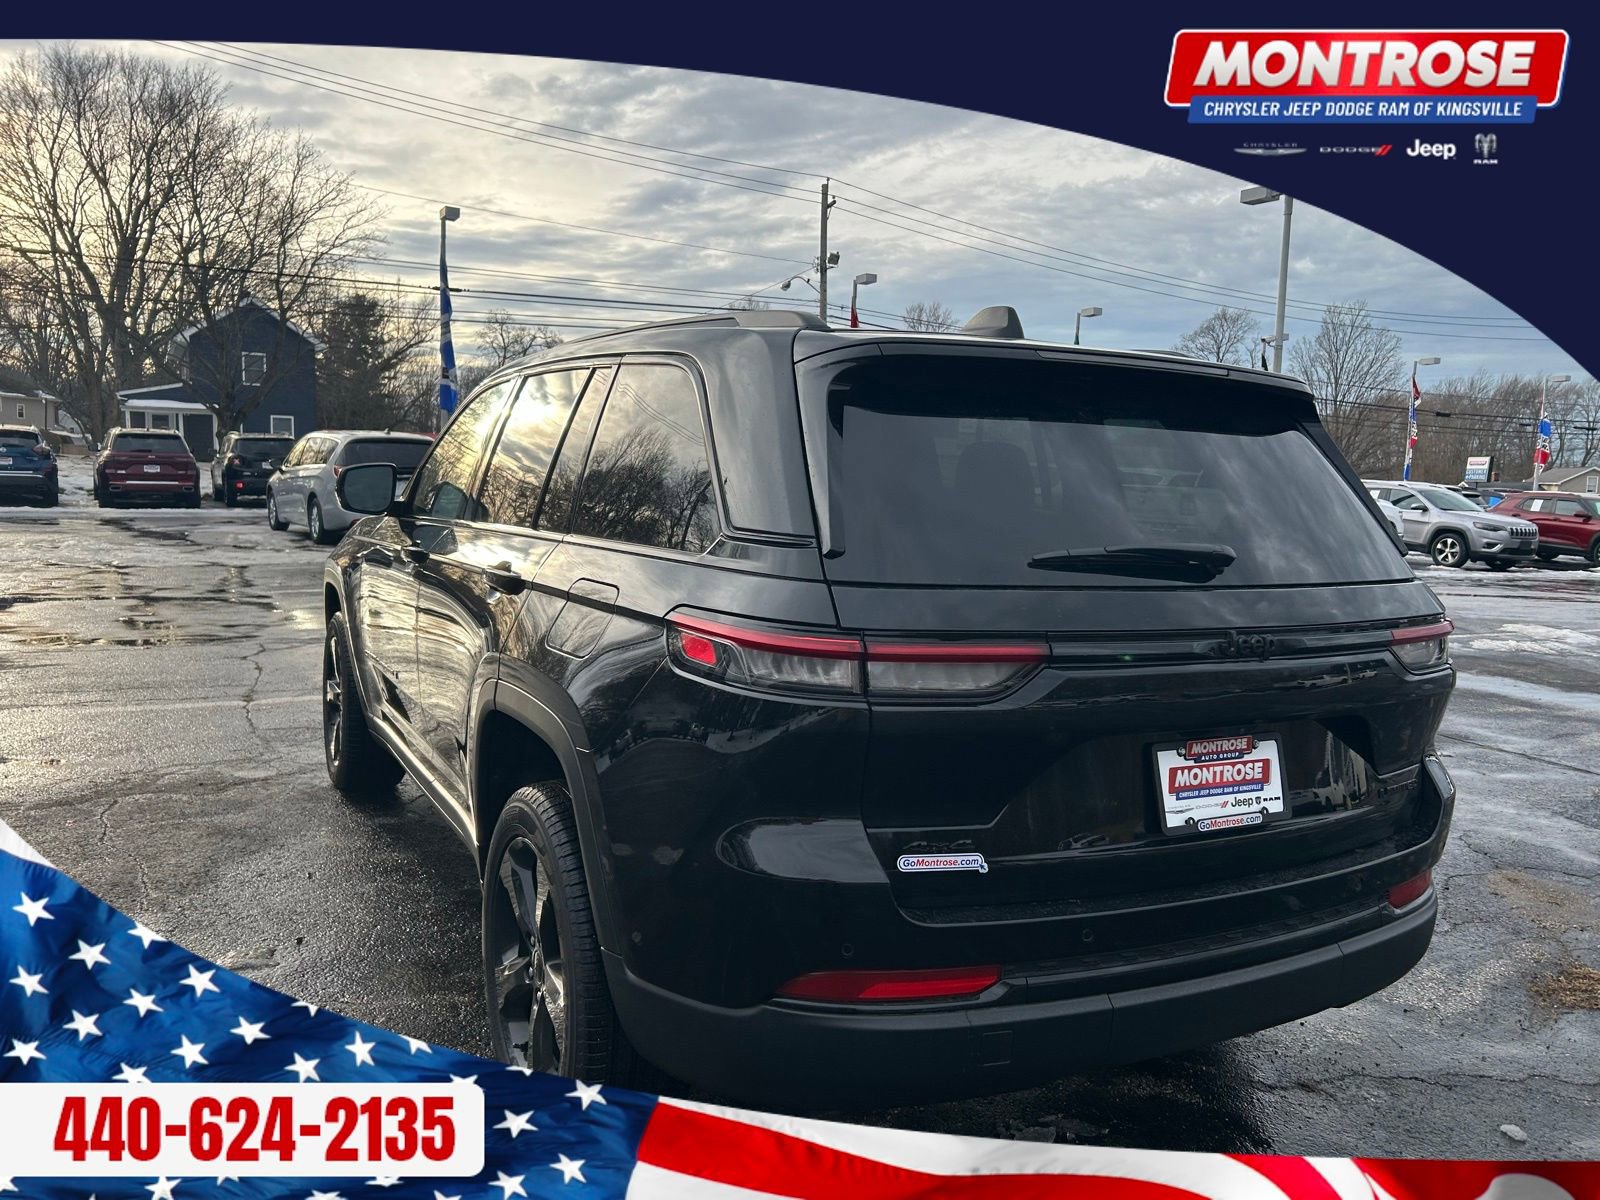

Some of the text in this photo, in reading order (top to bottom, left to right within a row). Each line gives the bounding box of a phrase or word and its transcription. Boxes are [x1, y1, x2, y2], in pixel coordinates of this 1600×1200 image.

[1191, 738, 1248, 754] MONTROSE
[1175, 762, 1263, 788] MONTROSE
[1179, 790, 1199, 798] CHRYSLER
[1240, 783, 1261, 791] KINGSVILLE
[1231, 796, 1253, 808] Jeep
[1200, 815, 1261, 830] GoMontrose.com
[903, 858, 979, 868] GoMontrose.com
